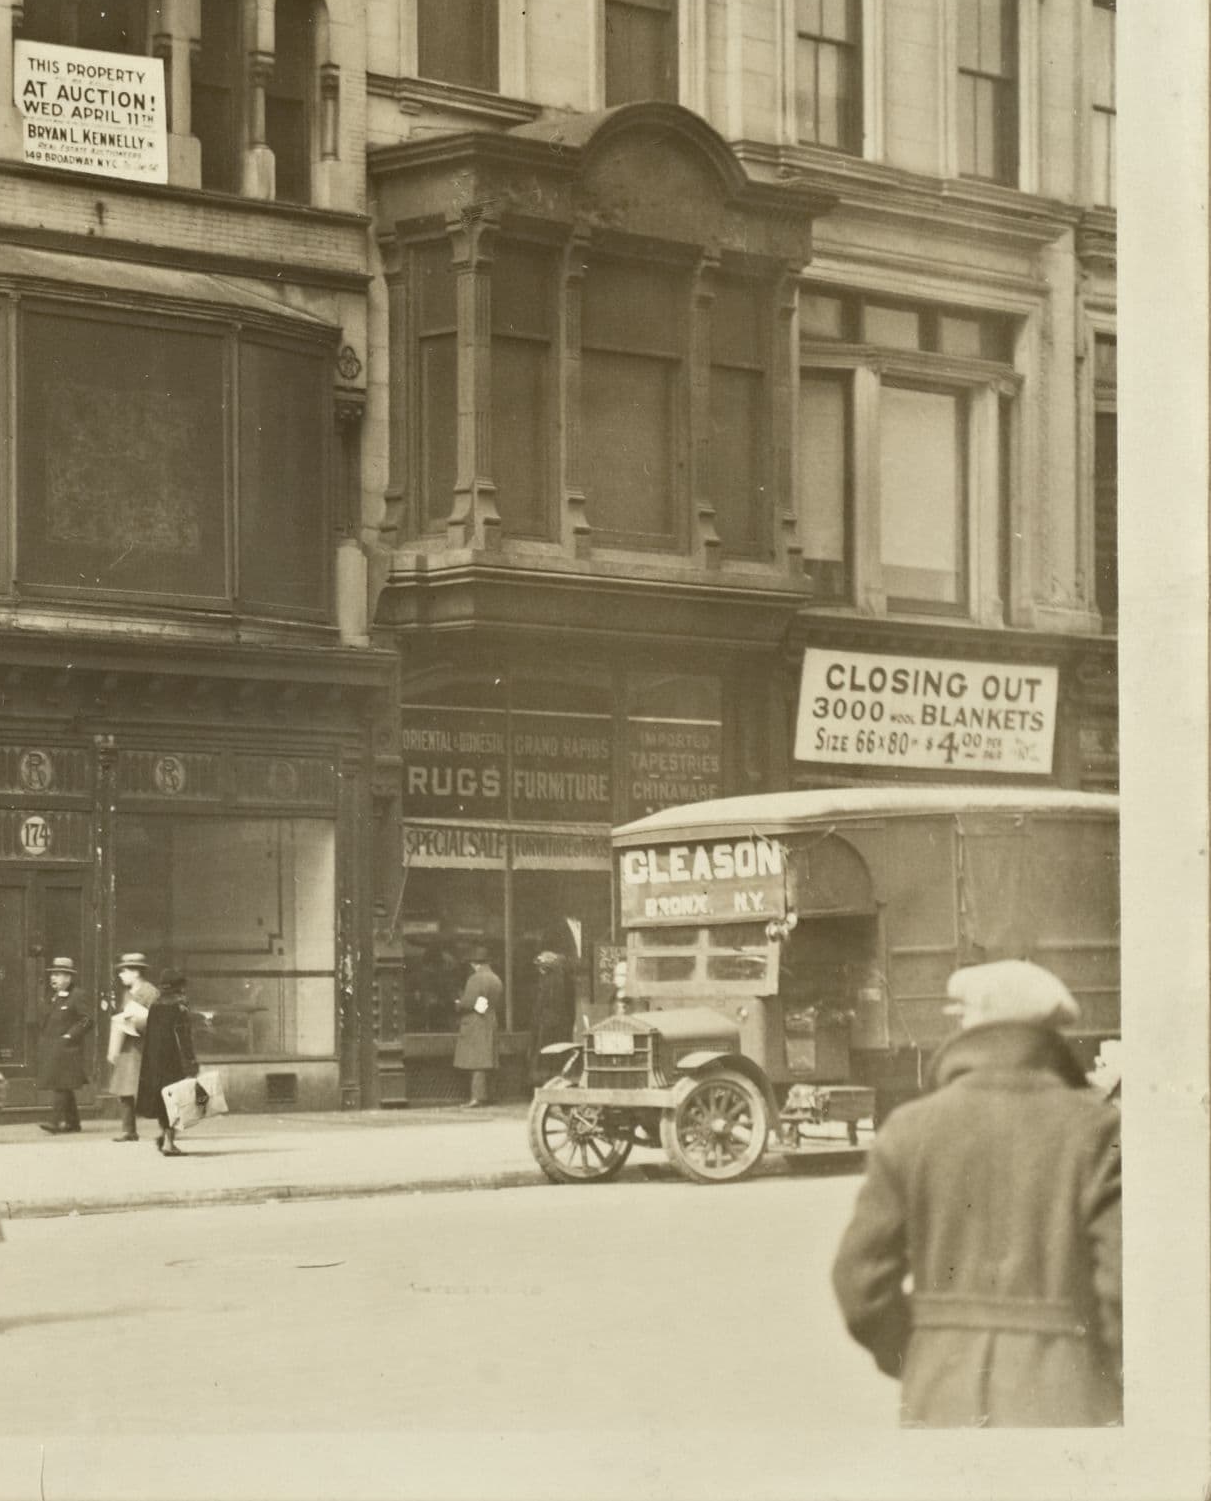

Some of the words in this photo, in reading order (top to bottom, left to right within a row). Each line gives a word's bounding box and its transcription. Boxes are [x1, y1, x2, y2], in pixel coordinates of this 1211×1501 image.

[27, 57, 60, 74] THIS
[66, 62, 146, 85] PROPERTY
[23, 79, 47, 99] AT
[57, 84, 155, 112] AUCTION!
[71, 106, 121, 124] APRIL
[27, 123, 67, 143] BRYAN
[83, 129, 145, 150] KENNELLY
[45, 152, 93, 166] BROADWAY
[825, 663, 969, 699] CLOSING
[982, 675, 1042, 704] OUT
[812, 697, 885, 722] 3000
[921, 704, 1045, 732] BLANKETS
[402, 729, 452, 752] ORIENTAL
[629, 751, 720, 773] TAPESTRIES
[407, 765, 501, 798] RUGS
[513, 768, 610, 802] FURNITURE
[632, 781, 717, 802] CHINAWARE
[26, 823, 51, 847] 174
[405, 829, 465, 858] SPECIAL
[468, 831, 503, 859] SALE
[623, 840, 782, 885] GLEASON
